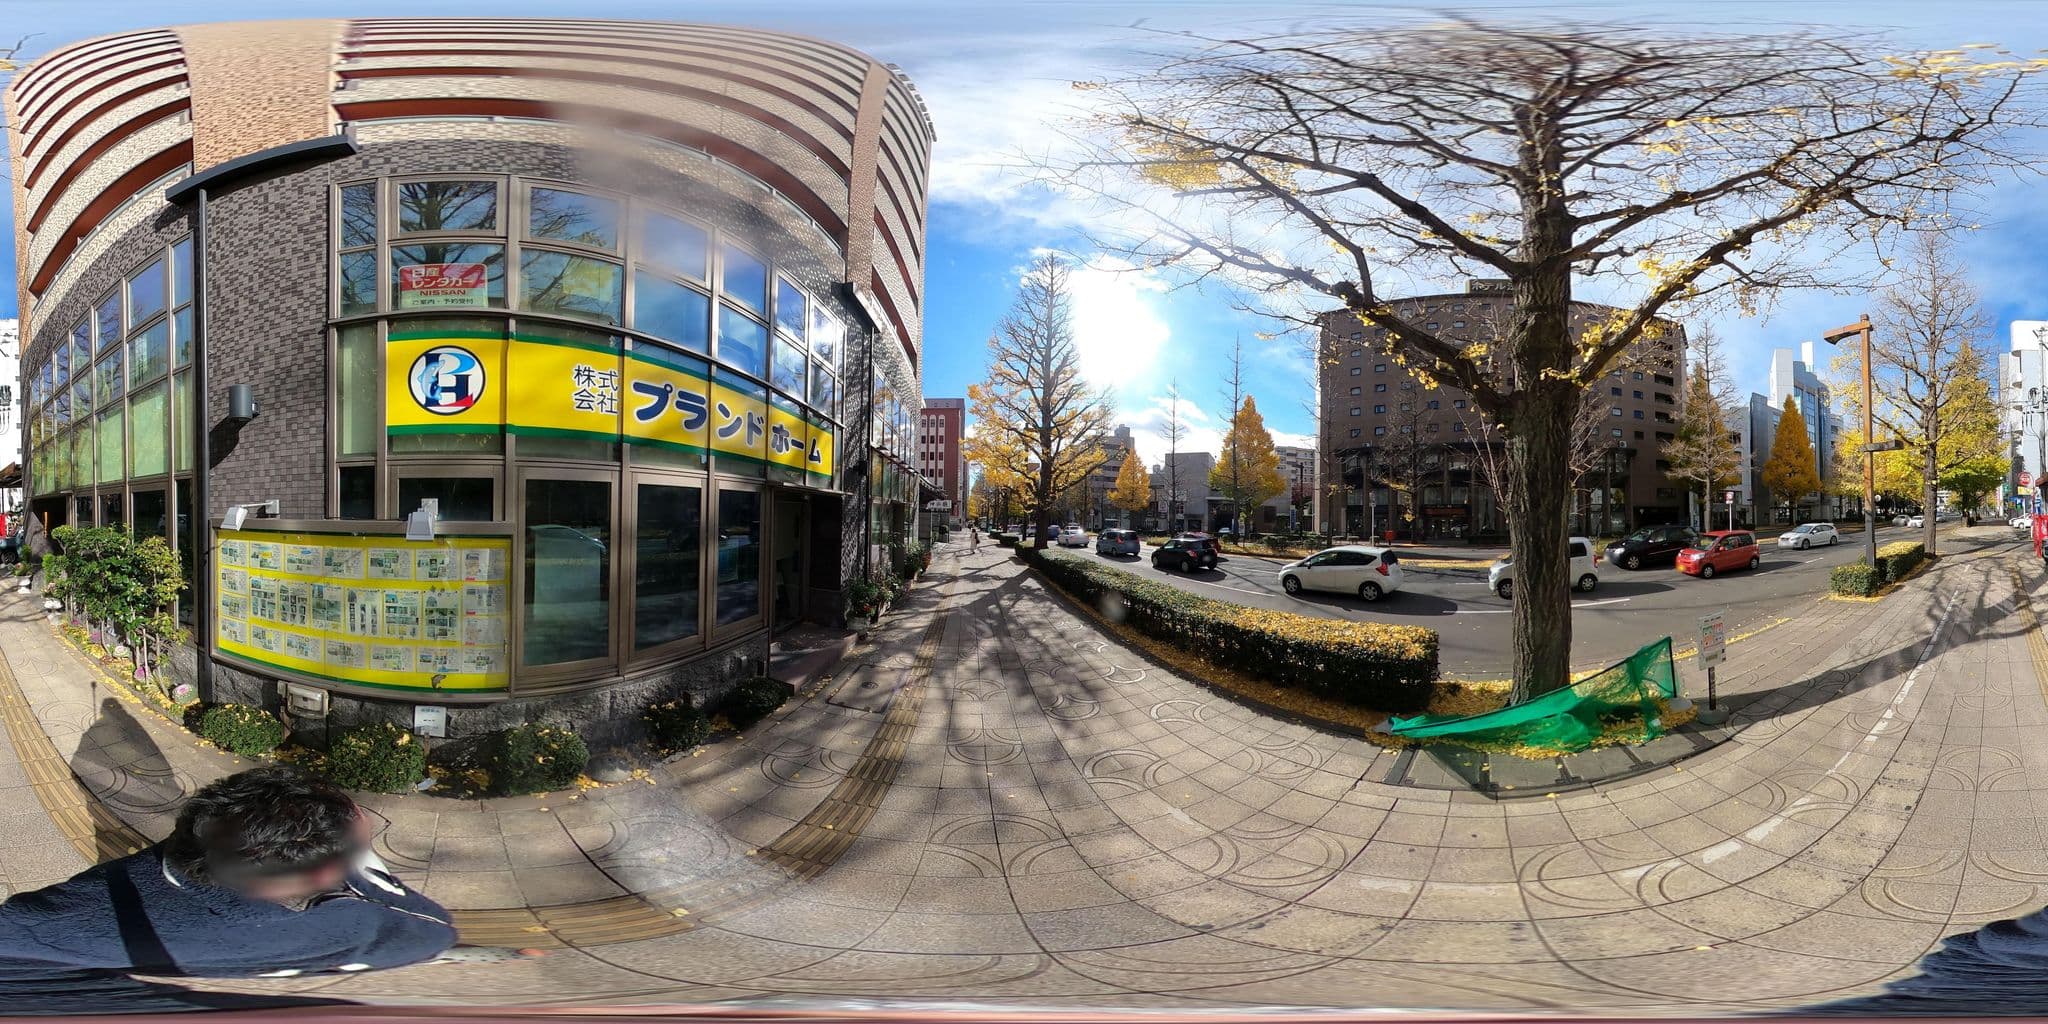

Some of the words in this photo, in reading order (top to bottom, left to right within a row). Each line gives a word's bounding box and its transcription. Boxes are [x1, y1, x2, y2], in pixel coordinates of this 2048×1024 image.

[412, 267, 441, 278] 日産
[412, 277, 474, 289] レンタカー
[419, 289, 466, 297] NISSAN
[573, 365, 618, 392] 株式
[572, 387, 618, 415] 会社
[631, 380, 823, 465] プランドホーム
